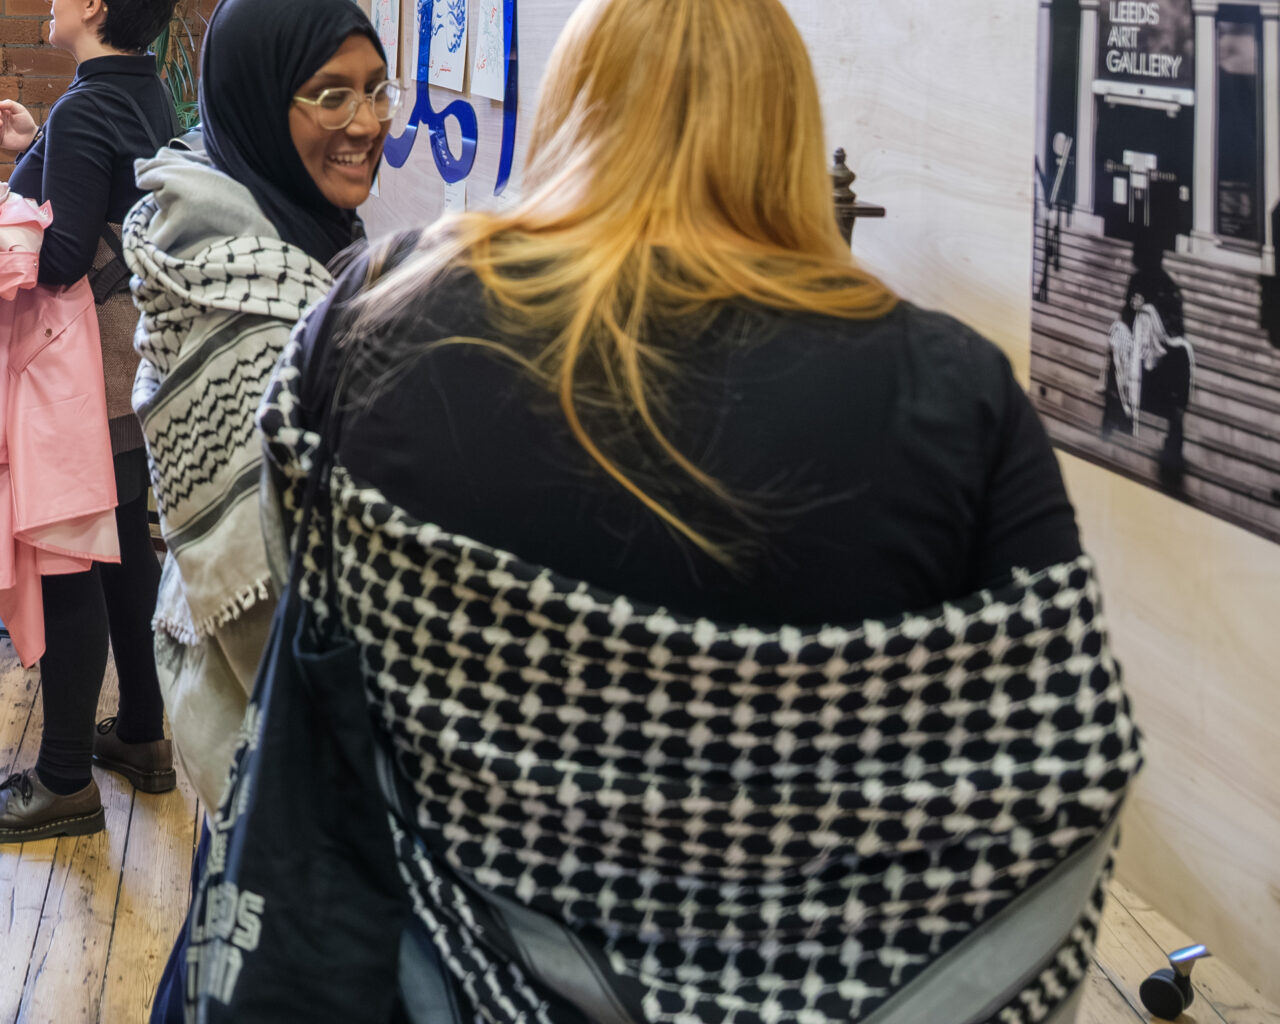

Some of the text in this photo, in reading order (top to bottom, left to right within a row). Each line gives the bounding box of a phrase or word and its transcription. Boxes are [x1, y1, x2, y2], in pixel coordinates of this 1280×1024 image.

[1109, 0, 1160, 25] LEEDS
[1107, 26, 1141, 48] ART
[1106, 50, 1183, 79] GALLERY
